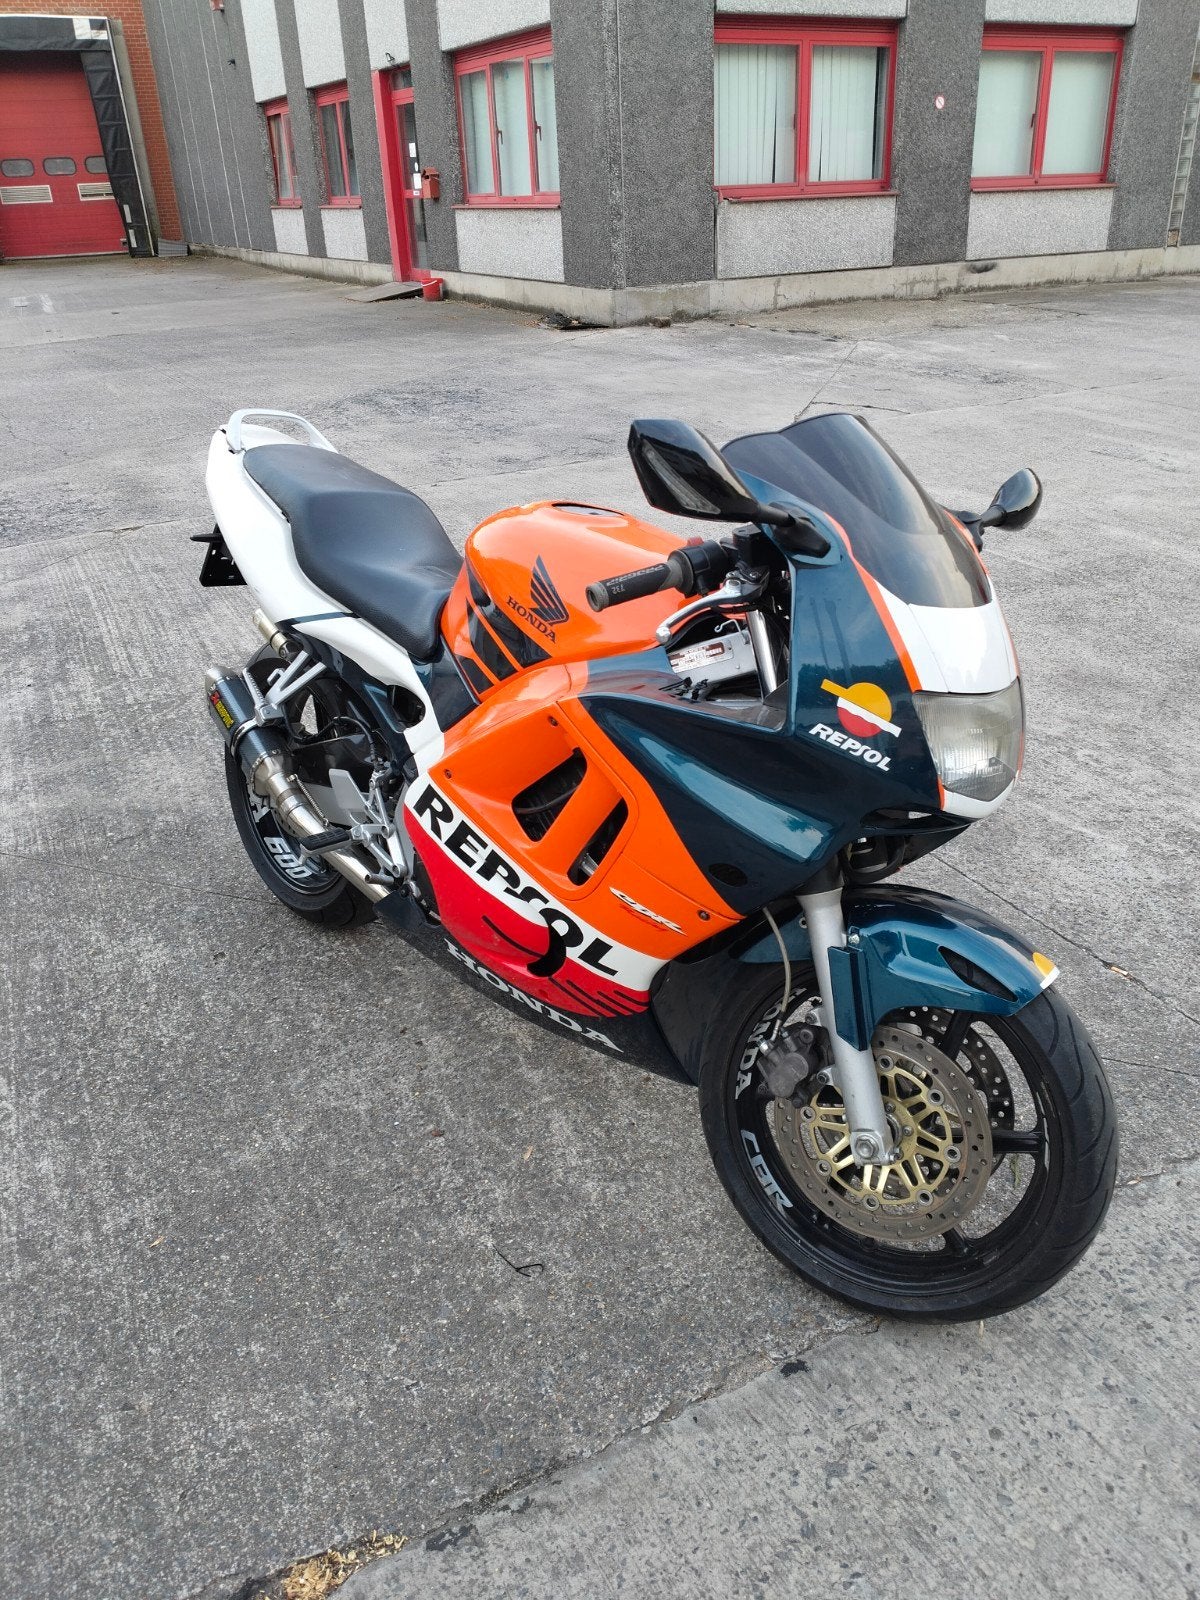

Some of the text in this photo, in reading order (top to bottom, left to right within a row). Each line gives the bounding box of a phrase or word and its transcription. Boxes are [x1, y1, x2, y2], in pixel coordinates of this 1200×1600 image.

[507, 595, 556, 644] HONDA
[808, 722, 891, 772] REPSOL
[263, 836, 313, 879] 600
[413, 783, 618, 978] REPSOL
[444, 938, 624, 1053] HONDA
[740, 1129, 794, 1219] CBR
